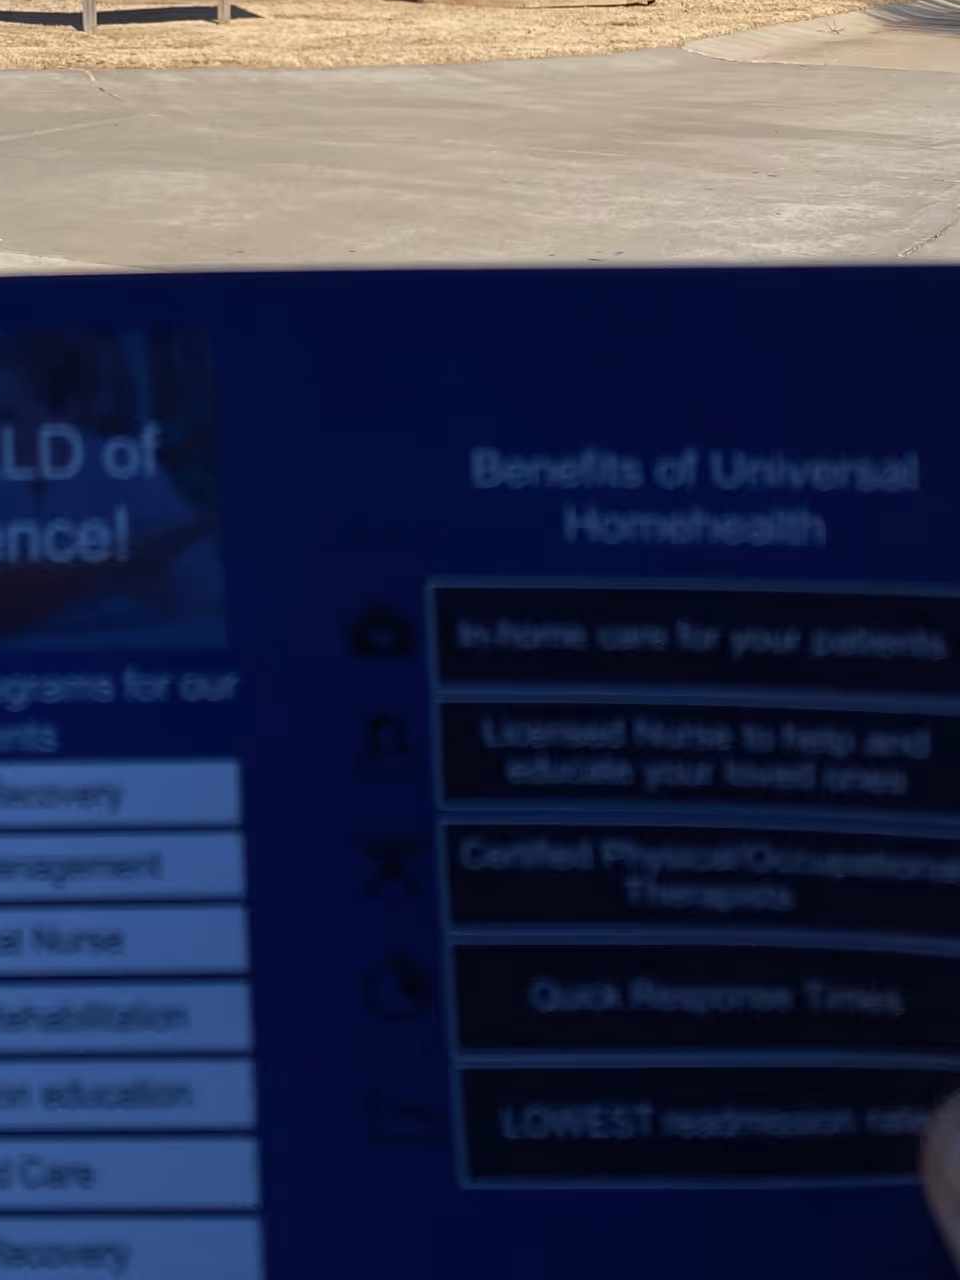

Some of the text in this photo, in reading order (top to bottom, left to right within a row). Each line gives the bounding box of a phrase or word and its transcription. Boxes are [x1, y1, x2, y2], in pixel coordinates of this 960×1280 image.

[101, 420, 162, 480] of
[470, 445, 921, 492] Benefits of Universal
[562, 503, 827, 547] Homehealth
[594, 623, 670, 652] care
[674, 617, 721, 651] for
[730, 624, 803, 662] your
[809, 624, 948, 660] patients
[122, 664, 170, 702] for
[179, 670, 240, 702] our
[480, 714, 932, 759] Licensed Nurse to help and
[505, 755, 909, 796] educate your loved ones
[458, 836, 595, 871] Certified
[624, 873, 797, 913] Therapists
[30, 923, 126, 958] Nurse
[527, 977, 906, 1017] Quick Response Times
[41, 1076, 193, 1111] education
[499, 1101, 655, 1141] LOWEST
[661, 1107, 854, 1140] readmission
[16, 1153, 96, 1191] Care
